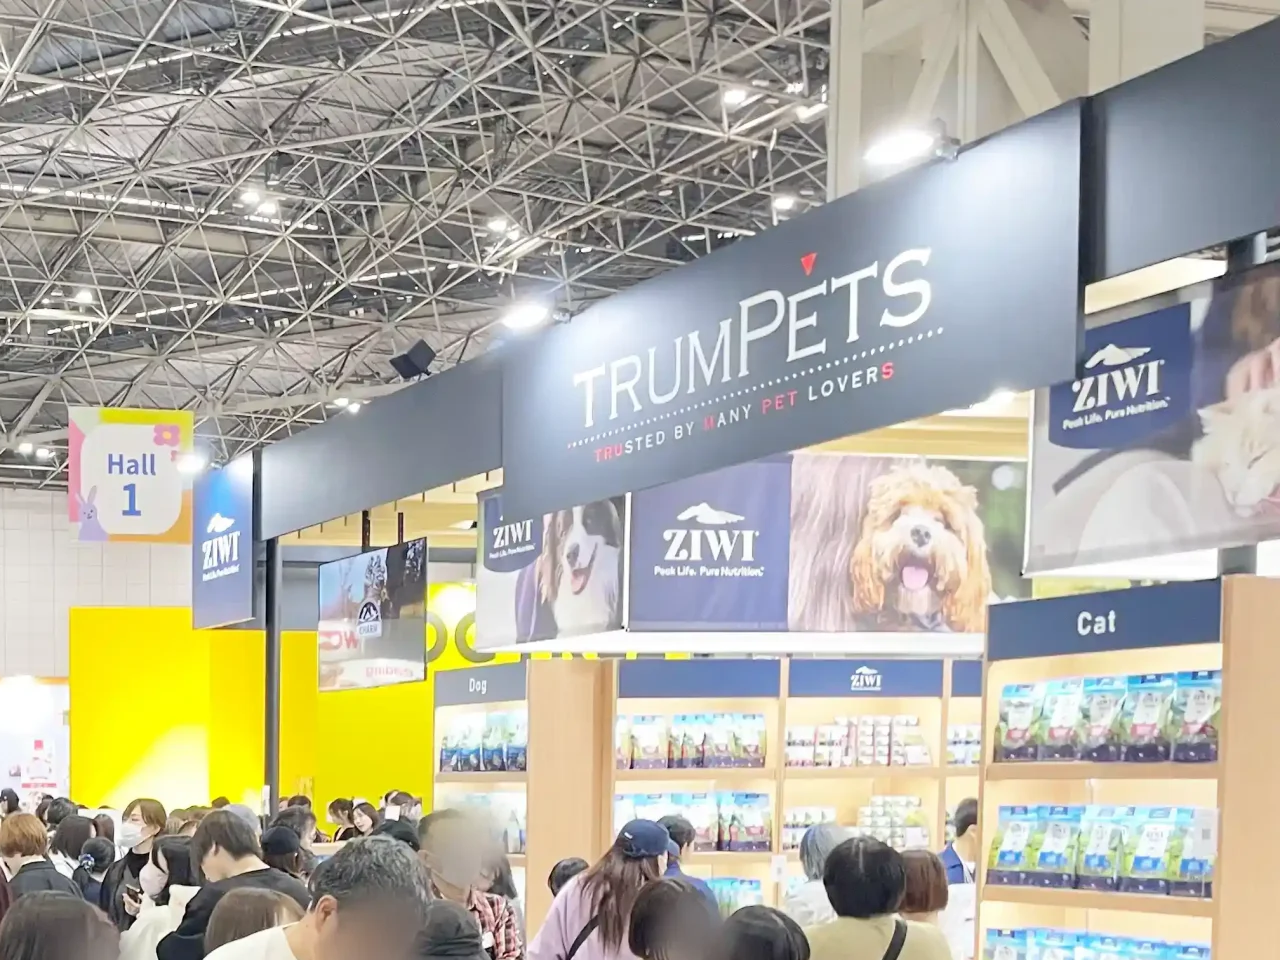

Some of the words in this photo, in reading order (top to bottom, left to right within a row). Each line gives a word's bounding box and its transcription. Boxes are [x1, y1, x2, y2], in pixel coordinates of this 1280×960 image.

[572, 247, 934, 429] TRUMPETS
[1071, 359, 1165, 413] ZIWI
[594, 431, 666, 463] TRUSTED
[673, 421, 695, 440] BY
[702, 404, 752, 432] MANY
[761, 391, 799, 415] PET
[807, 362, 896, 402] LOVERS
[106, 453, 157, 476] Hall
[121, 483, 142, 517] 1
[491, 518, 534, 549] ZIWI
[662, 529, 756, 562] ZIWI
[202, 530, 241, 571] ZIWI
[1077, 609, 1117, 636] Cat
[469, 677, 488, 694] Dog
[850, 674, 883, 688] ZIWI
